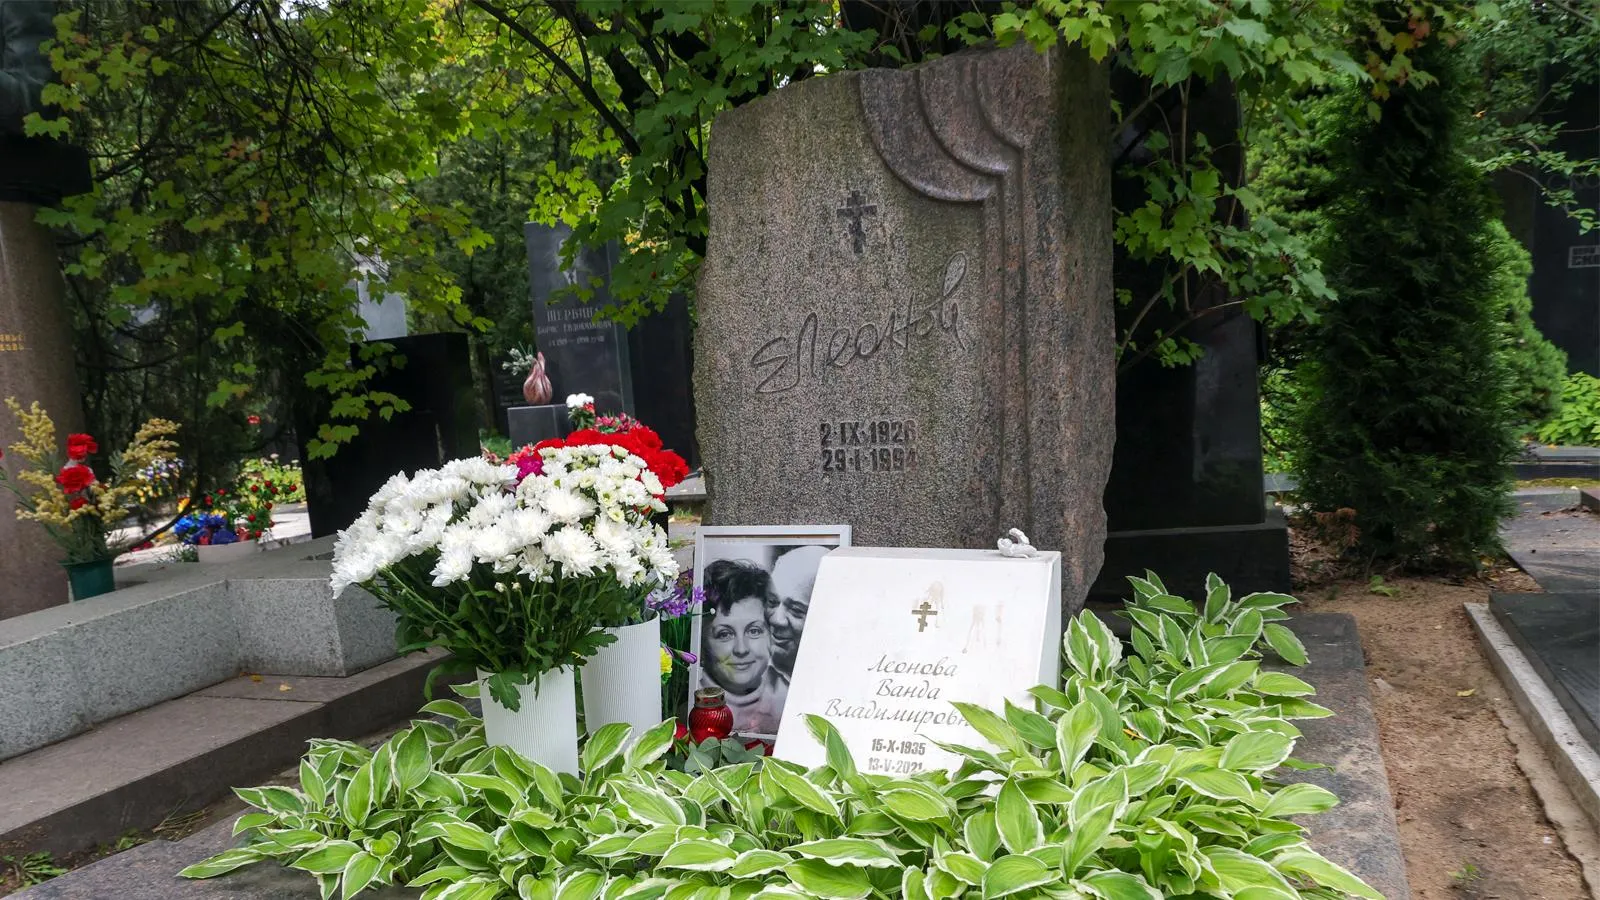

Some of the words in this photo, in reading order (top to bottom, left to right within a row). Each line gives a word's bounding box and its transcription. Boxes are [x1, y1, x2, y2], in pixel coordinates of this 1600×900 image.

[867, 654, 958, 678] Леонова
[876, 678, 941, 700] Ванда
[824, 698, 970, 733] Владимировн
